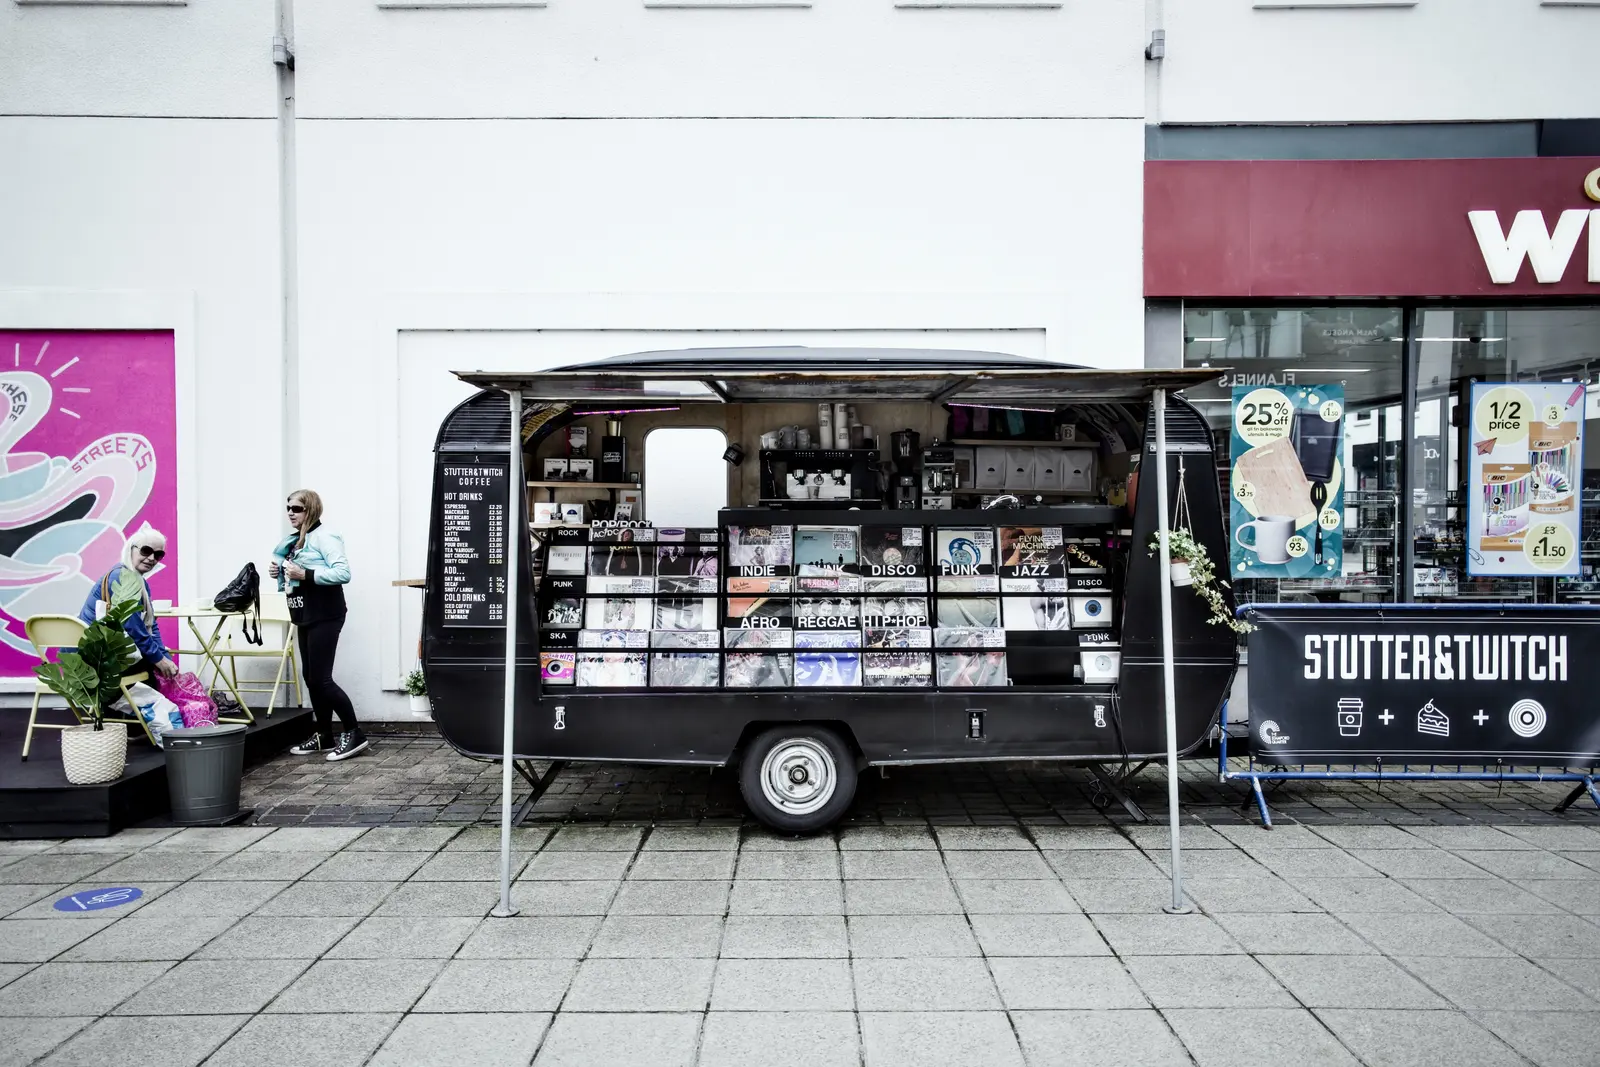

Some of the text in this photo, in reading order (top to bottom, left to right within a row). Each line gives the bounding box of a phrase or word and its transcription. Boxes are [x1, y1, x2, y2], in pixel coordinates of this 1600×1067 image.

[1, 383, 28, 422] THESE
[1242, 402, 1289, 426] 25%
[1490, 401, 1522, 420] 1/2
[1273, 416, 1289, 426] off
[1489, 420, 1521, 431] price
[71, 436, 153, 474] STREETS
[444, 467, 503, 477] STUTTER&TWITCH
[459, 477, 491, 486] COFFEE
[444, 492, 483, 501] HOT DRINKS
[594, 528, 619, 539] AC/DC
[1289, 542, 1306, 552] 93p
[1533, 536, 1566, 557] £1.50
[740, 565, 776, 577] INDIE
[871, 564, 917, 576] DISCO
[942, 564, 980, 576] FUNK
[1011, 565, 1050, 577] JAZZ
[444, 593, 486, 602] COLD DRINKS
[740, 617, 780, 629] AFRO
[798, 616, 857, 628] REGGAE
[549, 632, 567, 640] SKA
[1087, 633, 1110, 642] FUNK
[1303, 634, 1568, 681] STUTTER&TWITCH
